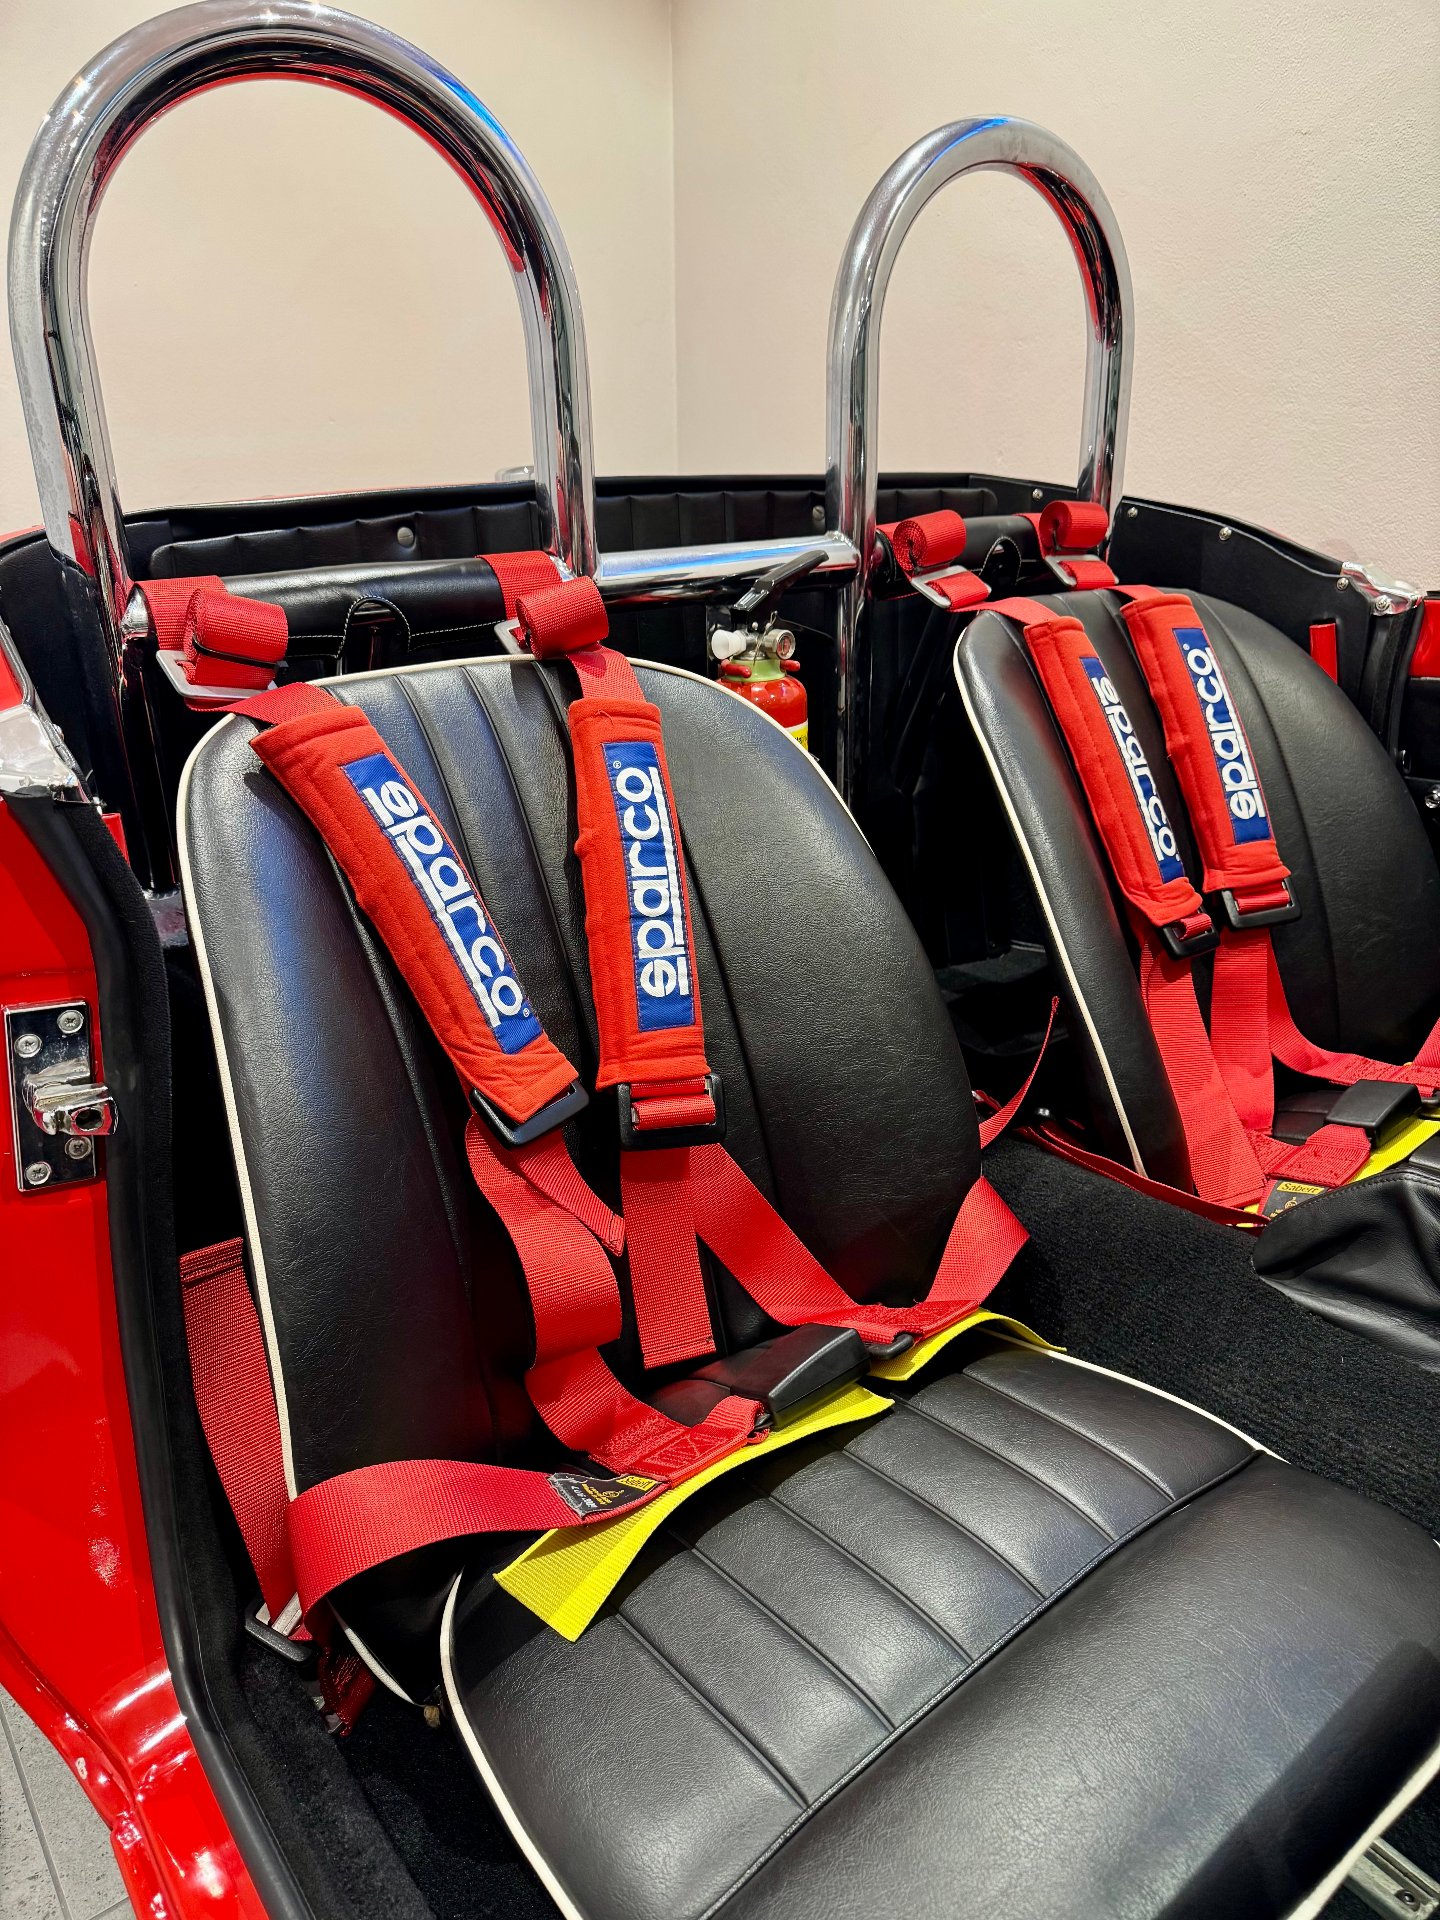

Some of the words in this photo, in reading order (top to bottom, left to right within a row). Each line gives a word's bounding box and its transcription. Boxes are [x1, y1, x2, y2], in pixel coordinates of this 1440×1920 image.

[1092, 676, 1176, 861] sparco
[1187, 647, 1266, 820] sparco
[362, 780, 525, 1028] sparco
[615, 767, 690, 998] sparco
